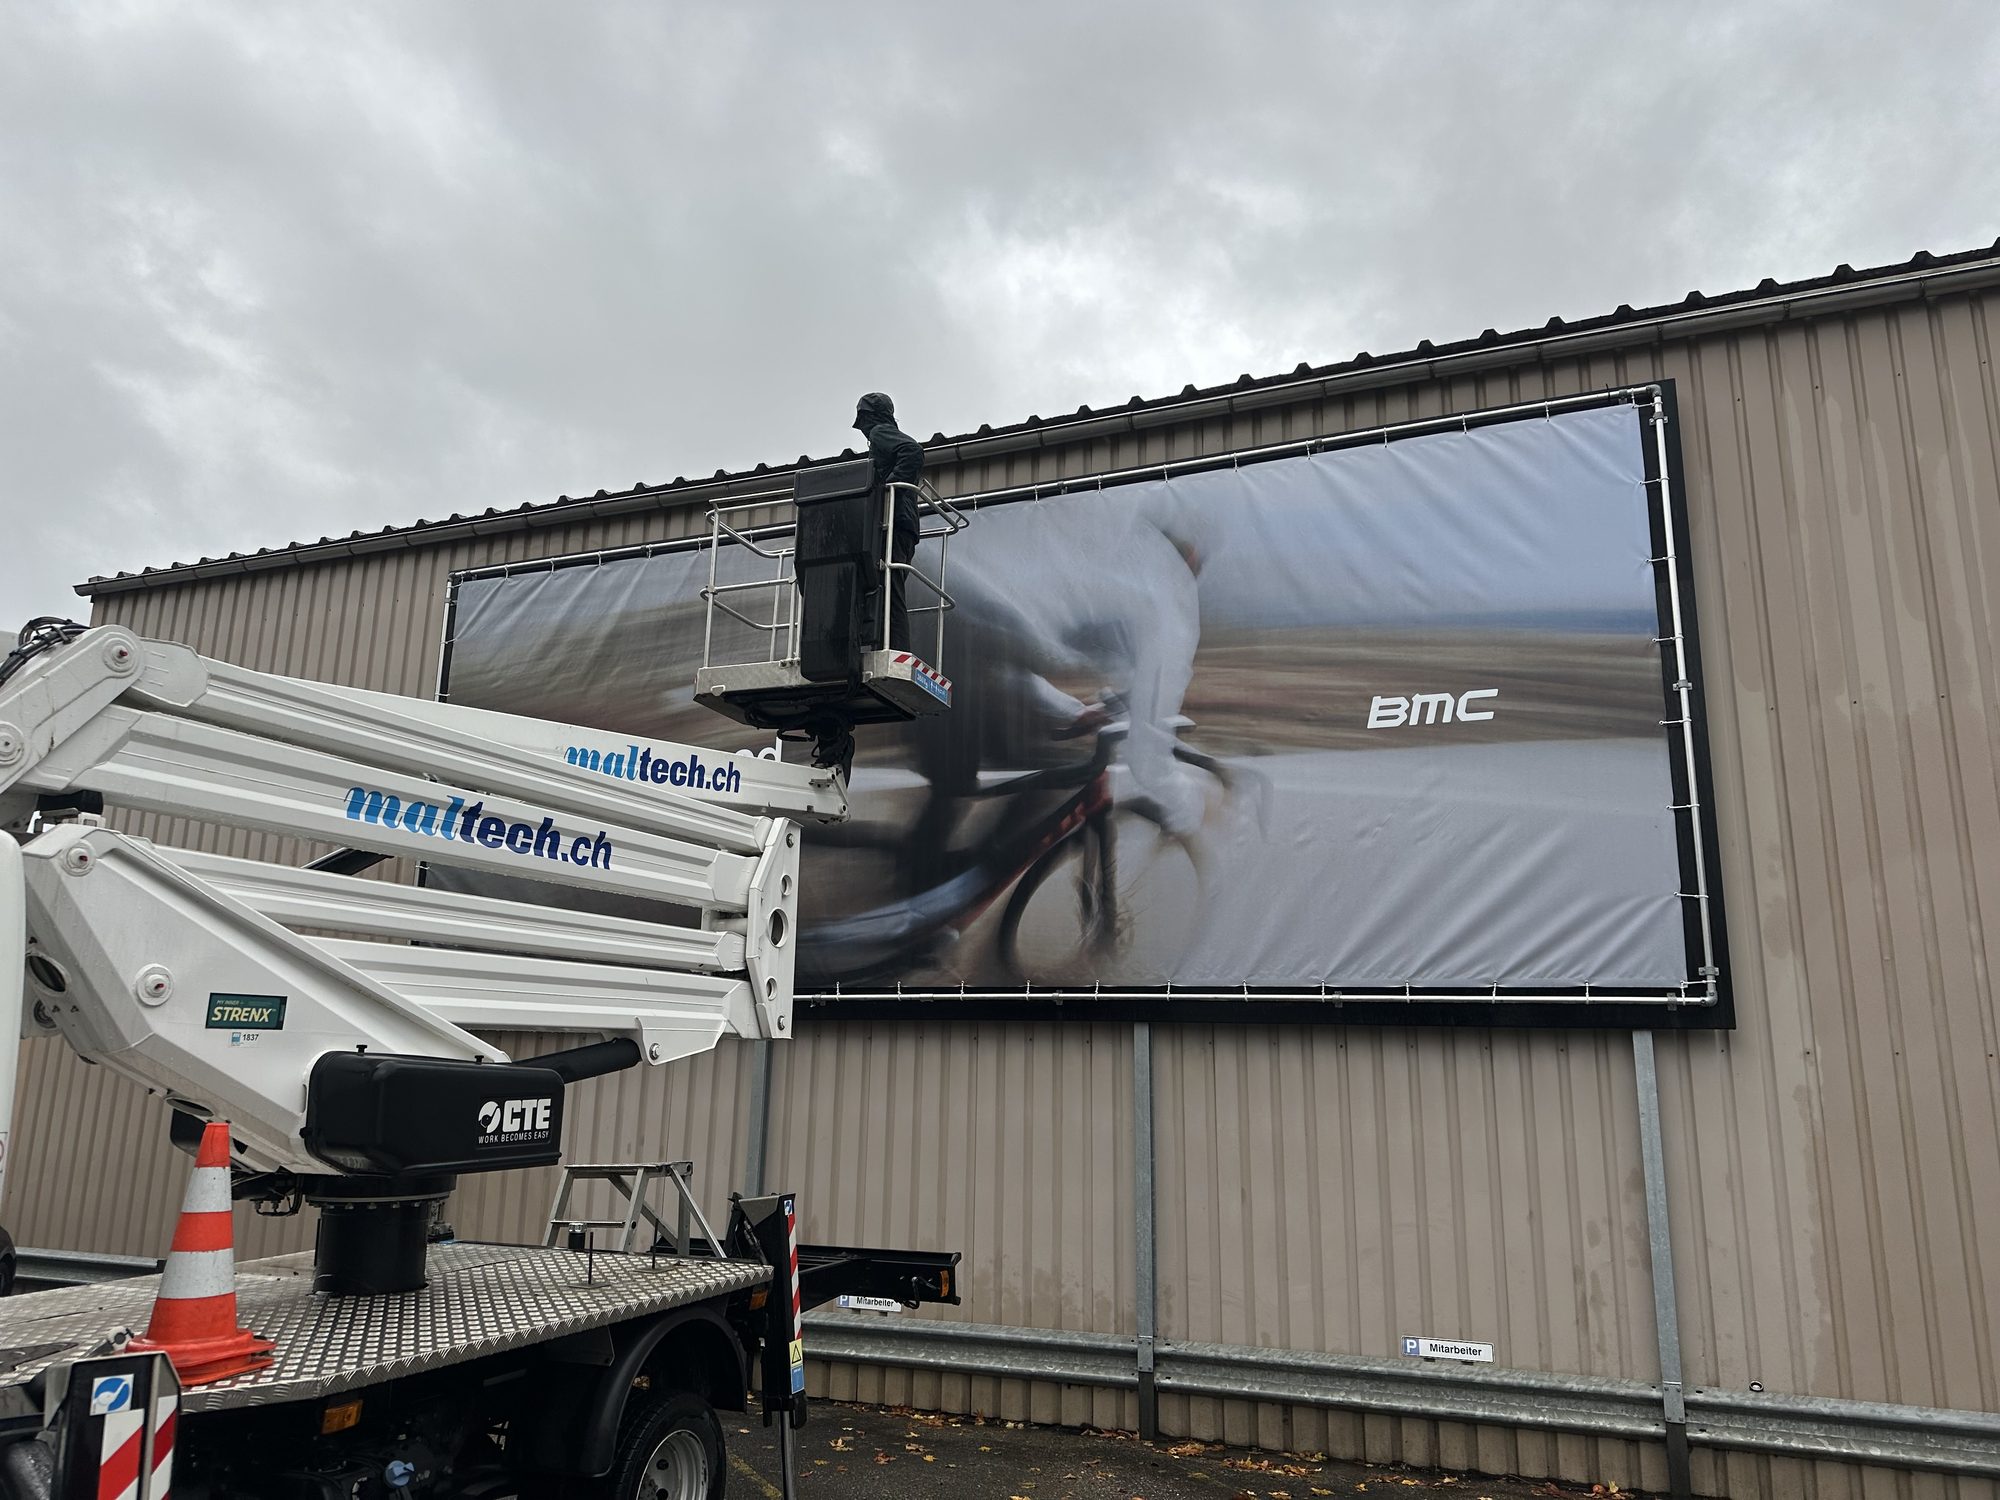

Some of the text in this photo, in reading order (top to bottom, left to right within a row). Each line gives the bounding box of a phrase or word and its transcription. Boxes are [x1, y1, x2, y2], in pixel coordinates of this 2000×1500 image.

[1367, 688, 1499, 729] BMC
[564, 744, 741, 793] maltech.ch
[343, 787, 611, 870] maltech.ch
[211, 1006, 272, 1023] STRENX
[242, 1033, 259, 1042] 1837
[502, 1098, 552, 1133] CTE
[478, 1130, 550, 1145] WORK BECOMES EASY
[1406, 1339, 1482, 1356] P Mitarbeiter
